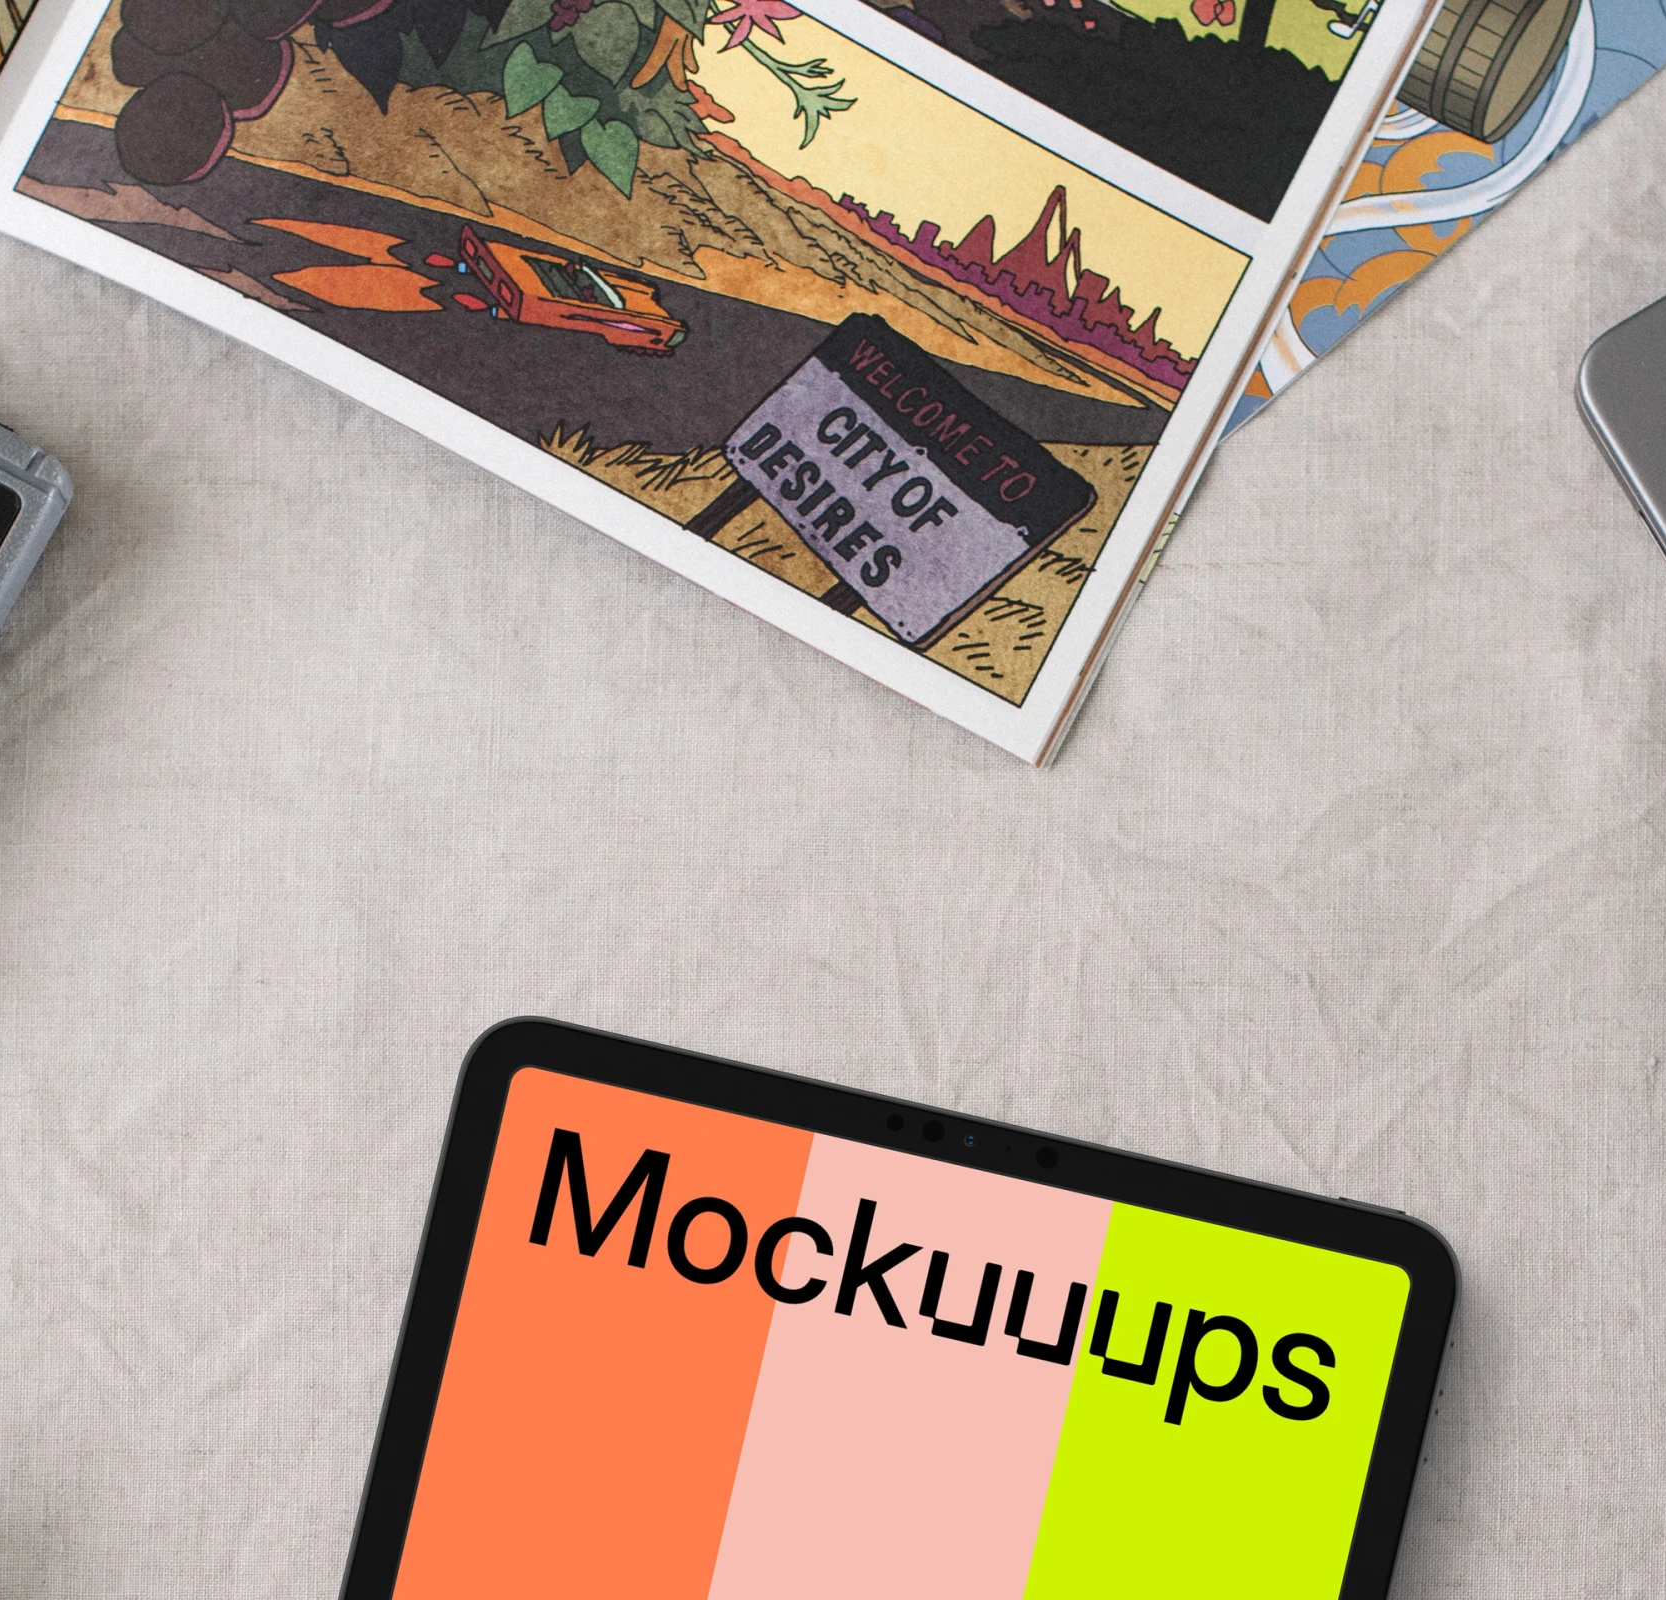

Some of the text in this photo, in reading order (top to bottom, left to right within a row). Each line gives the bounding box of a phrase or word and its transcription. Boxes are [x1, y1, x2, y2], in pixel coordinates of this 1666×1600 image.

[817, 406, 959, 534] CITY OF
[848, 337, 1037, 504] WELCOME TO
[739, 422, 903, 588] DESIRES
[529, 1128, 1336, 1426] Mockuuups
